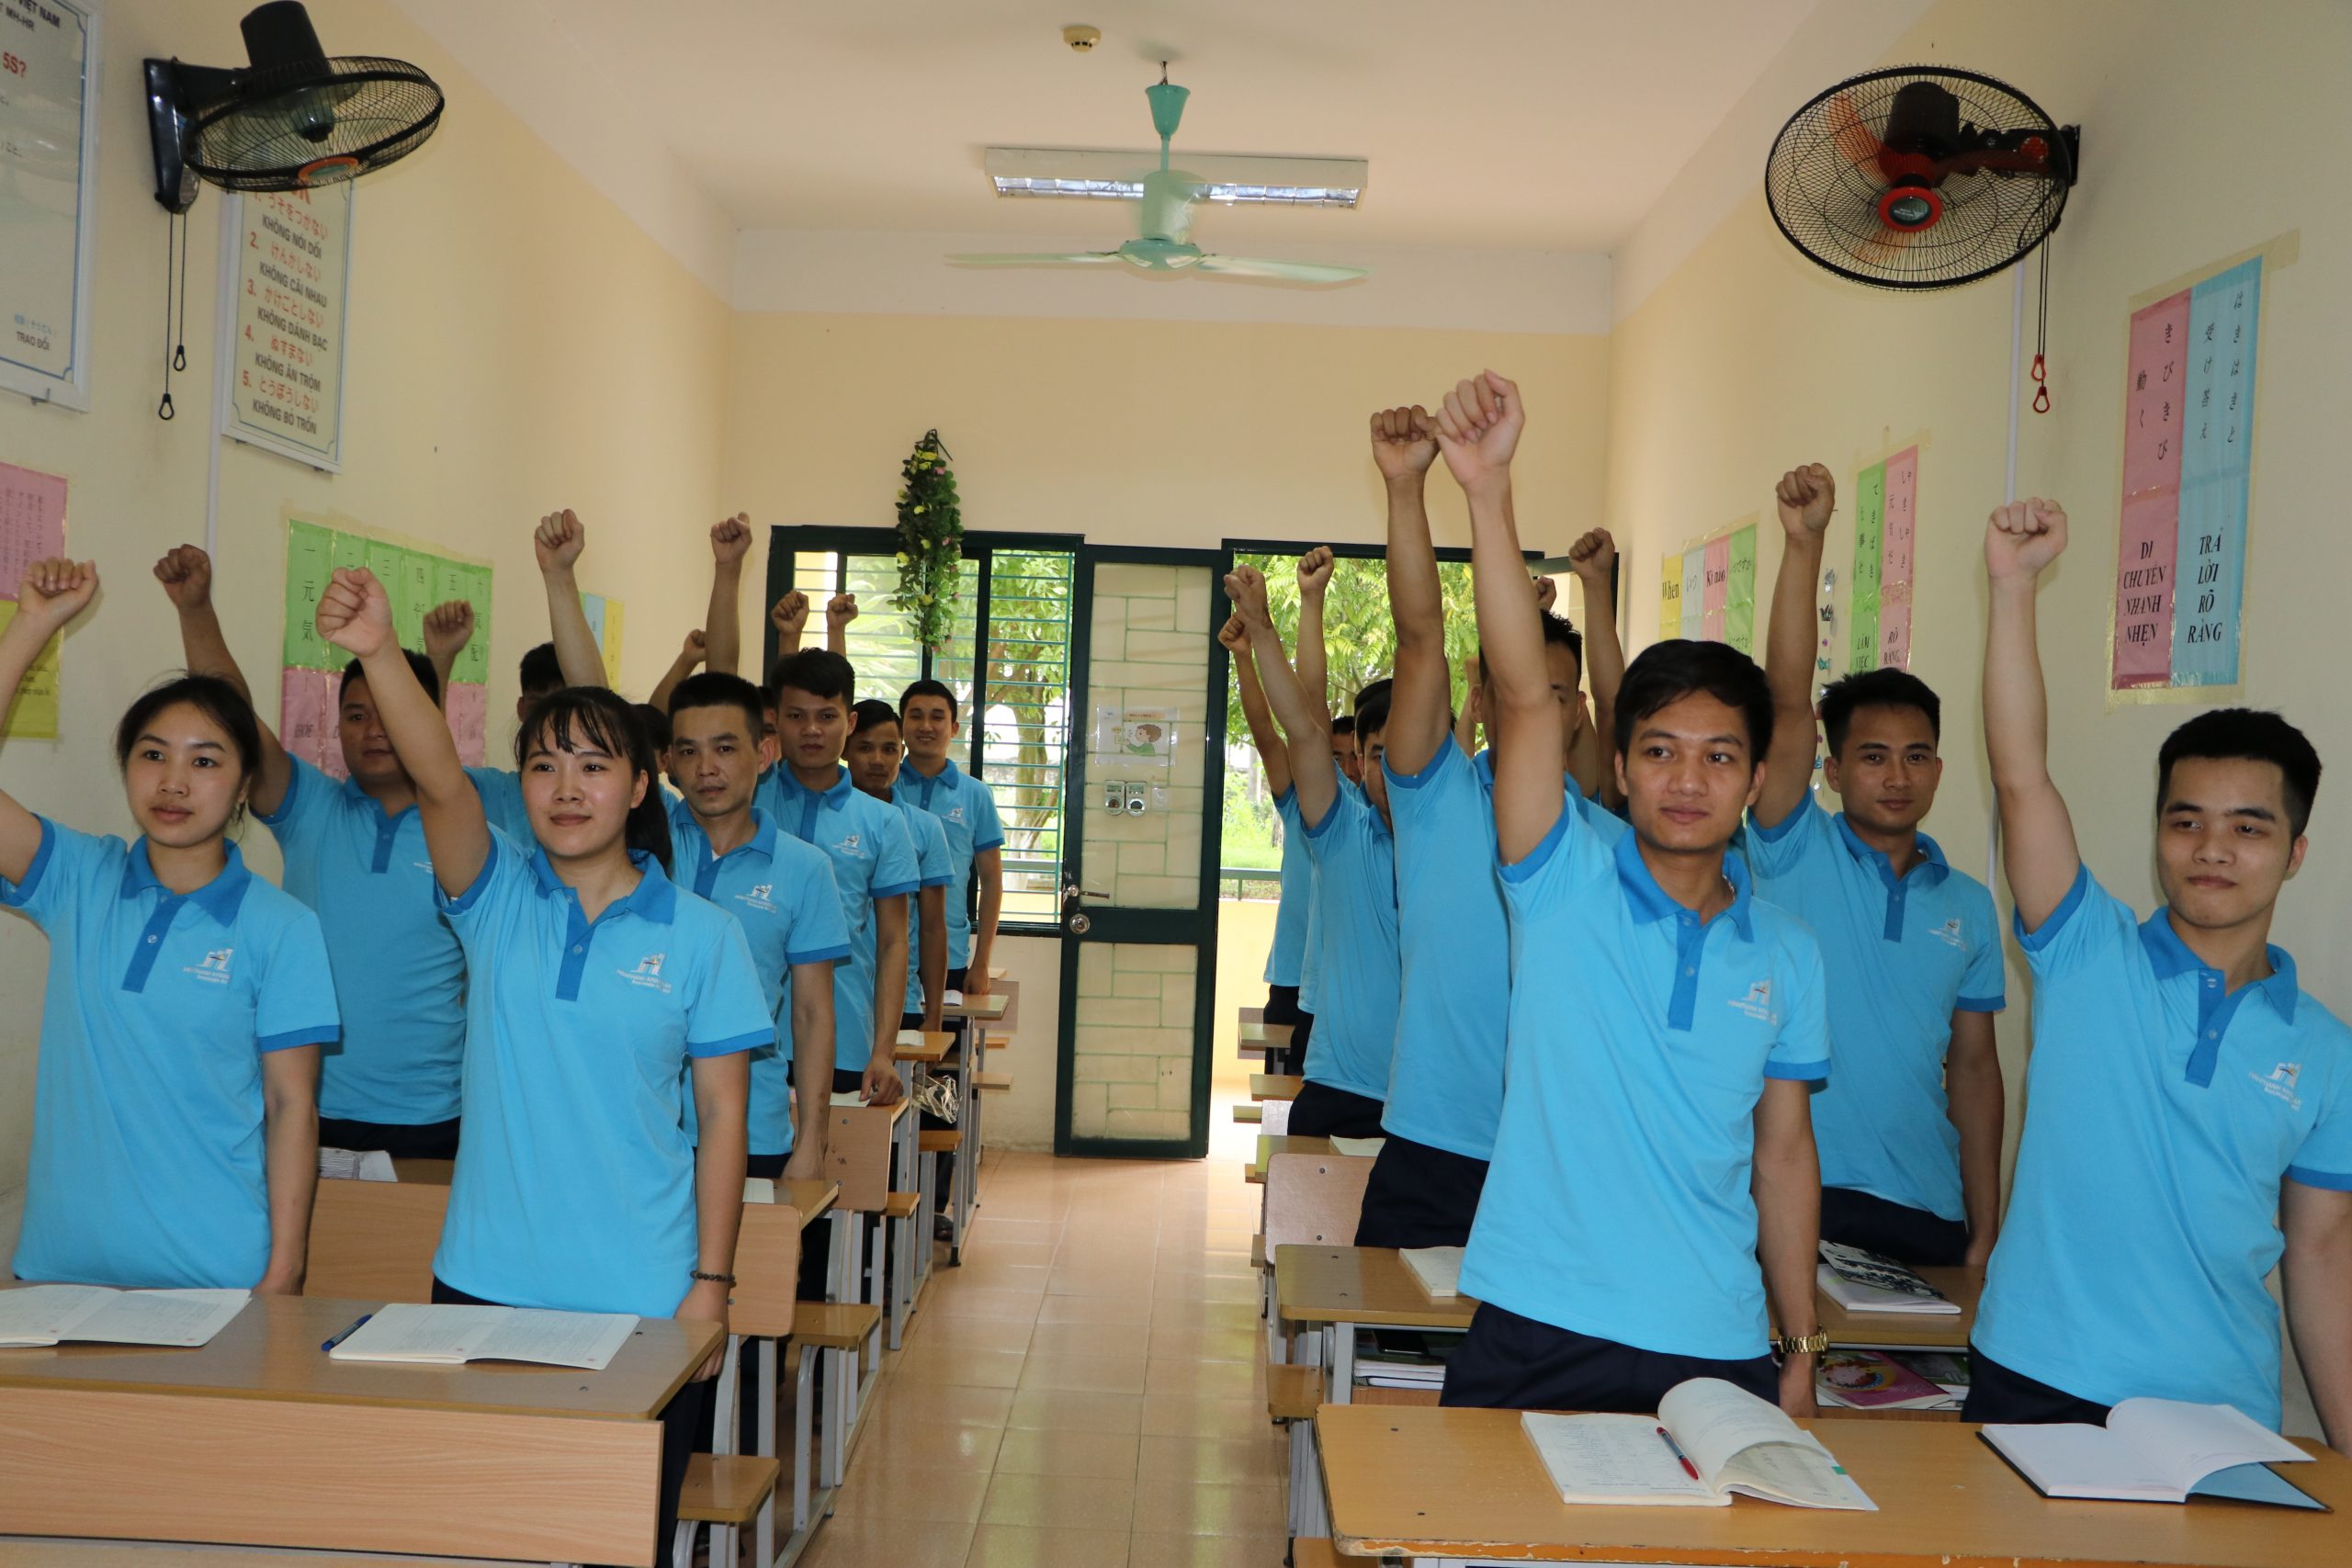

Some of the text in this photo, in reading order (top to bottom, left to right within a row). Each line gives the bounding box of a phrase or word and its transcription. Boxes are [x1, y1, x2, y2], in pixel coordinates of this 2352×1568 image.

[40, 6, 60, 28] NAM
[3, 51, 26, 78] 5S?
[249, 231, 259, 250] 2.
[262, 214, 322, 259] KHÔNG NÓI DỐI
[247, 278, 257, 296] 3.
[259, 262, 288, 288] KHÔNG
[305, 286, 327, 308] NHAU
[17, 331, 36, 346] TRAO
[244, 323, 254, 342] 4.
[257, 306, 287, 332] KHÔNG
[312, 336, 328, 353] BẠC
[243, 369, 252, 388] 5.
[255, 353, 284, 377] KHÔNG
[300, 372, 321, 393] TRỘM
[2158, 323, 2175, 460] きびきび
[253, 399, 281, 422] KHÔNG
[296, 413, 317, 434] TRỐN
[2141, 540, 2154, 559] DI
[2199, 526, 2223, 555] TRẢ
[2123, 561, 2166, 590] CHUYỂN
[2198, 558, 2219, 585] LỜI
[1661, 581, 1679, 600] When
[2198, 589, 2215, 614] RÕ
[2123, 594, 2162, 616] NHANH
[2188, 619, 2223, 644] RÀNG
